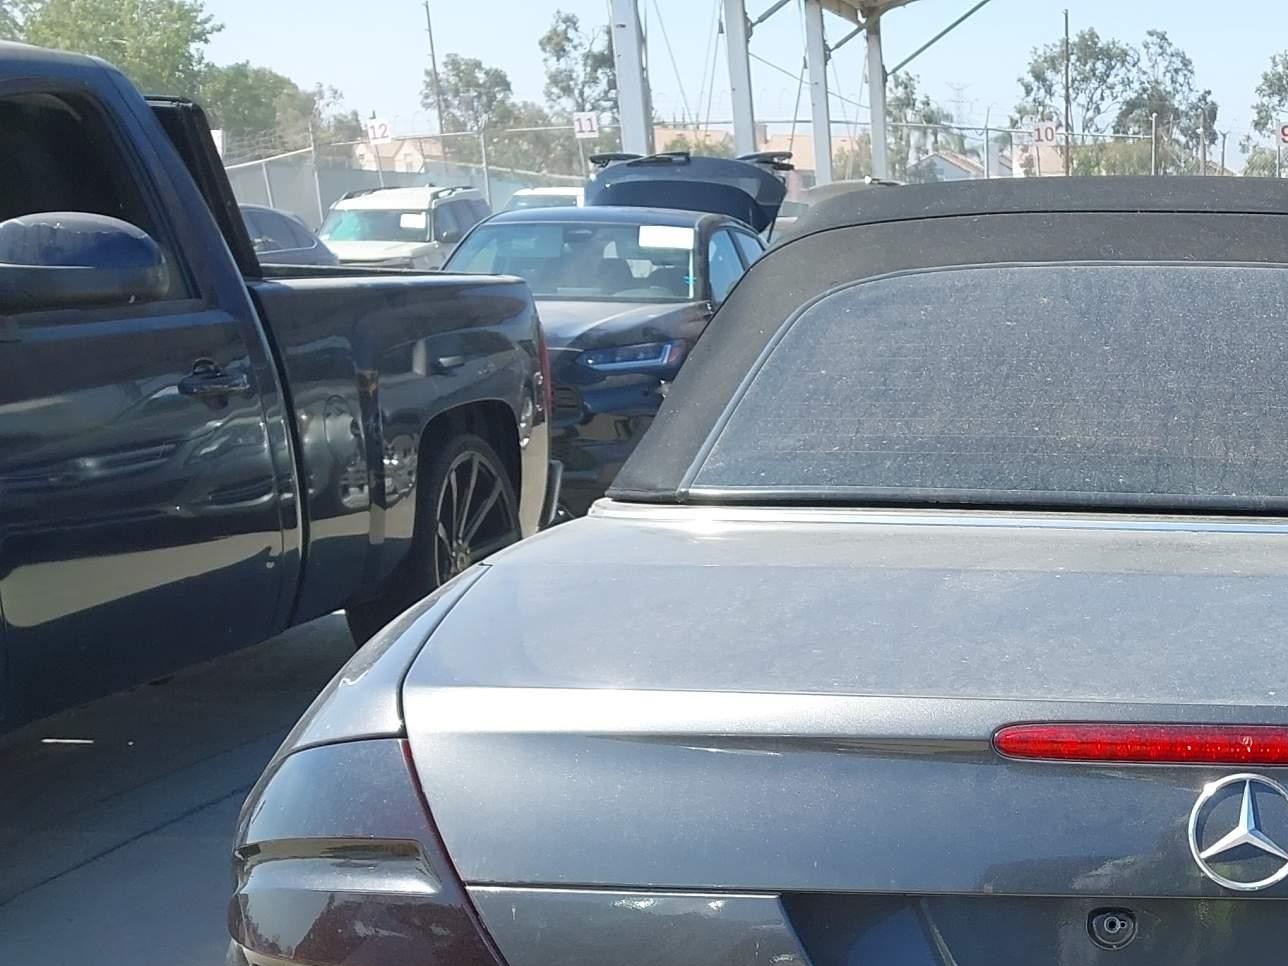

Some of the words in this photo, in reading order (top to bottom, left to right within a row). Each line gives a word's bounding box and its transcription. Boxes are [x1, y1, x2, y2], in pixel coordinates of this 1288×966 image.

[370, 122, 390, 141] 12
[575, 117, 596, 134] 11
[1034, 126, 1055, 143] 10
